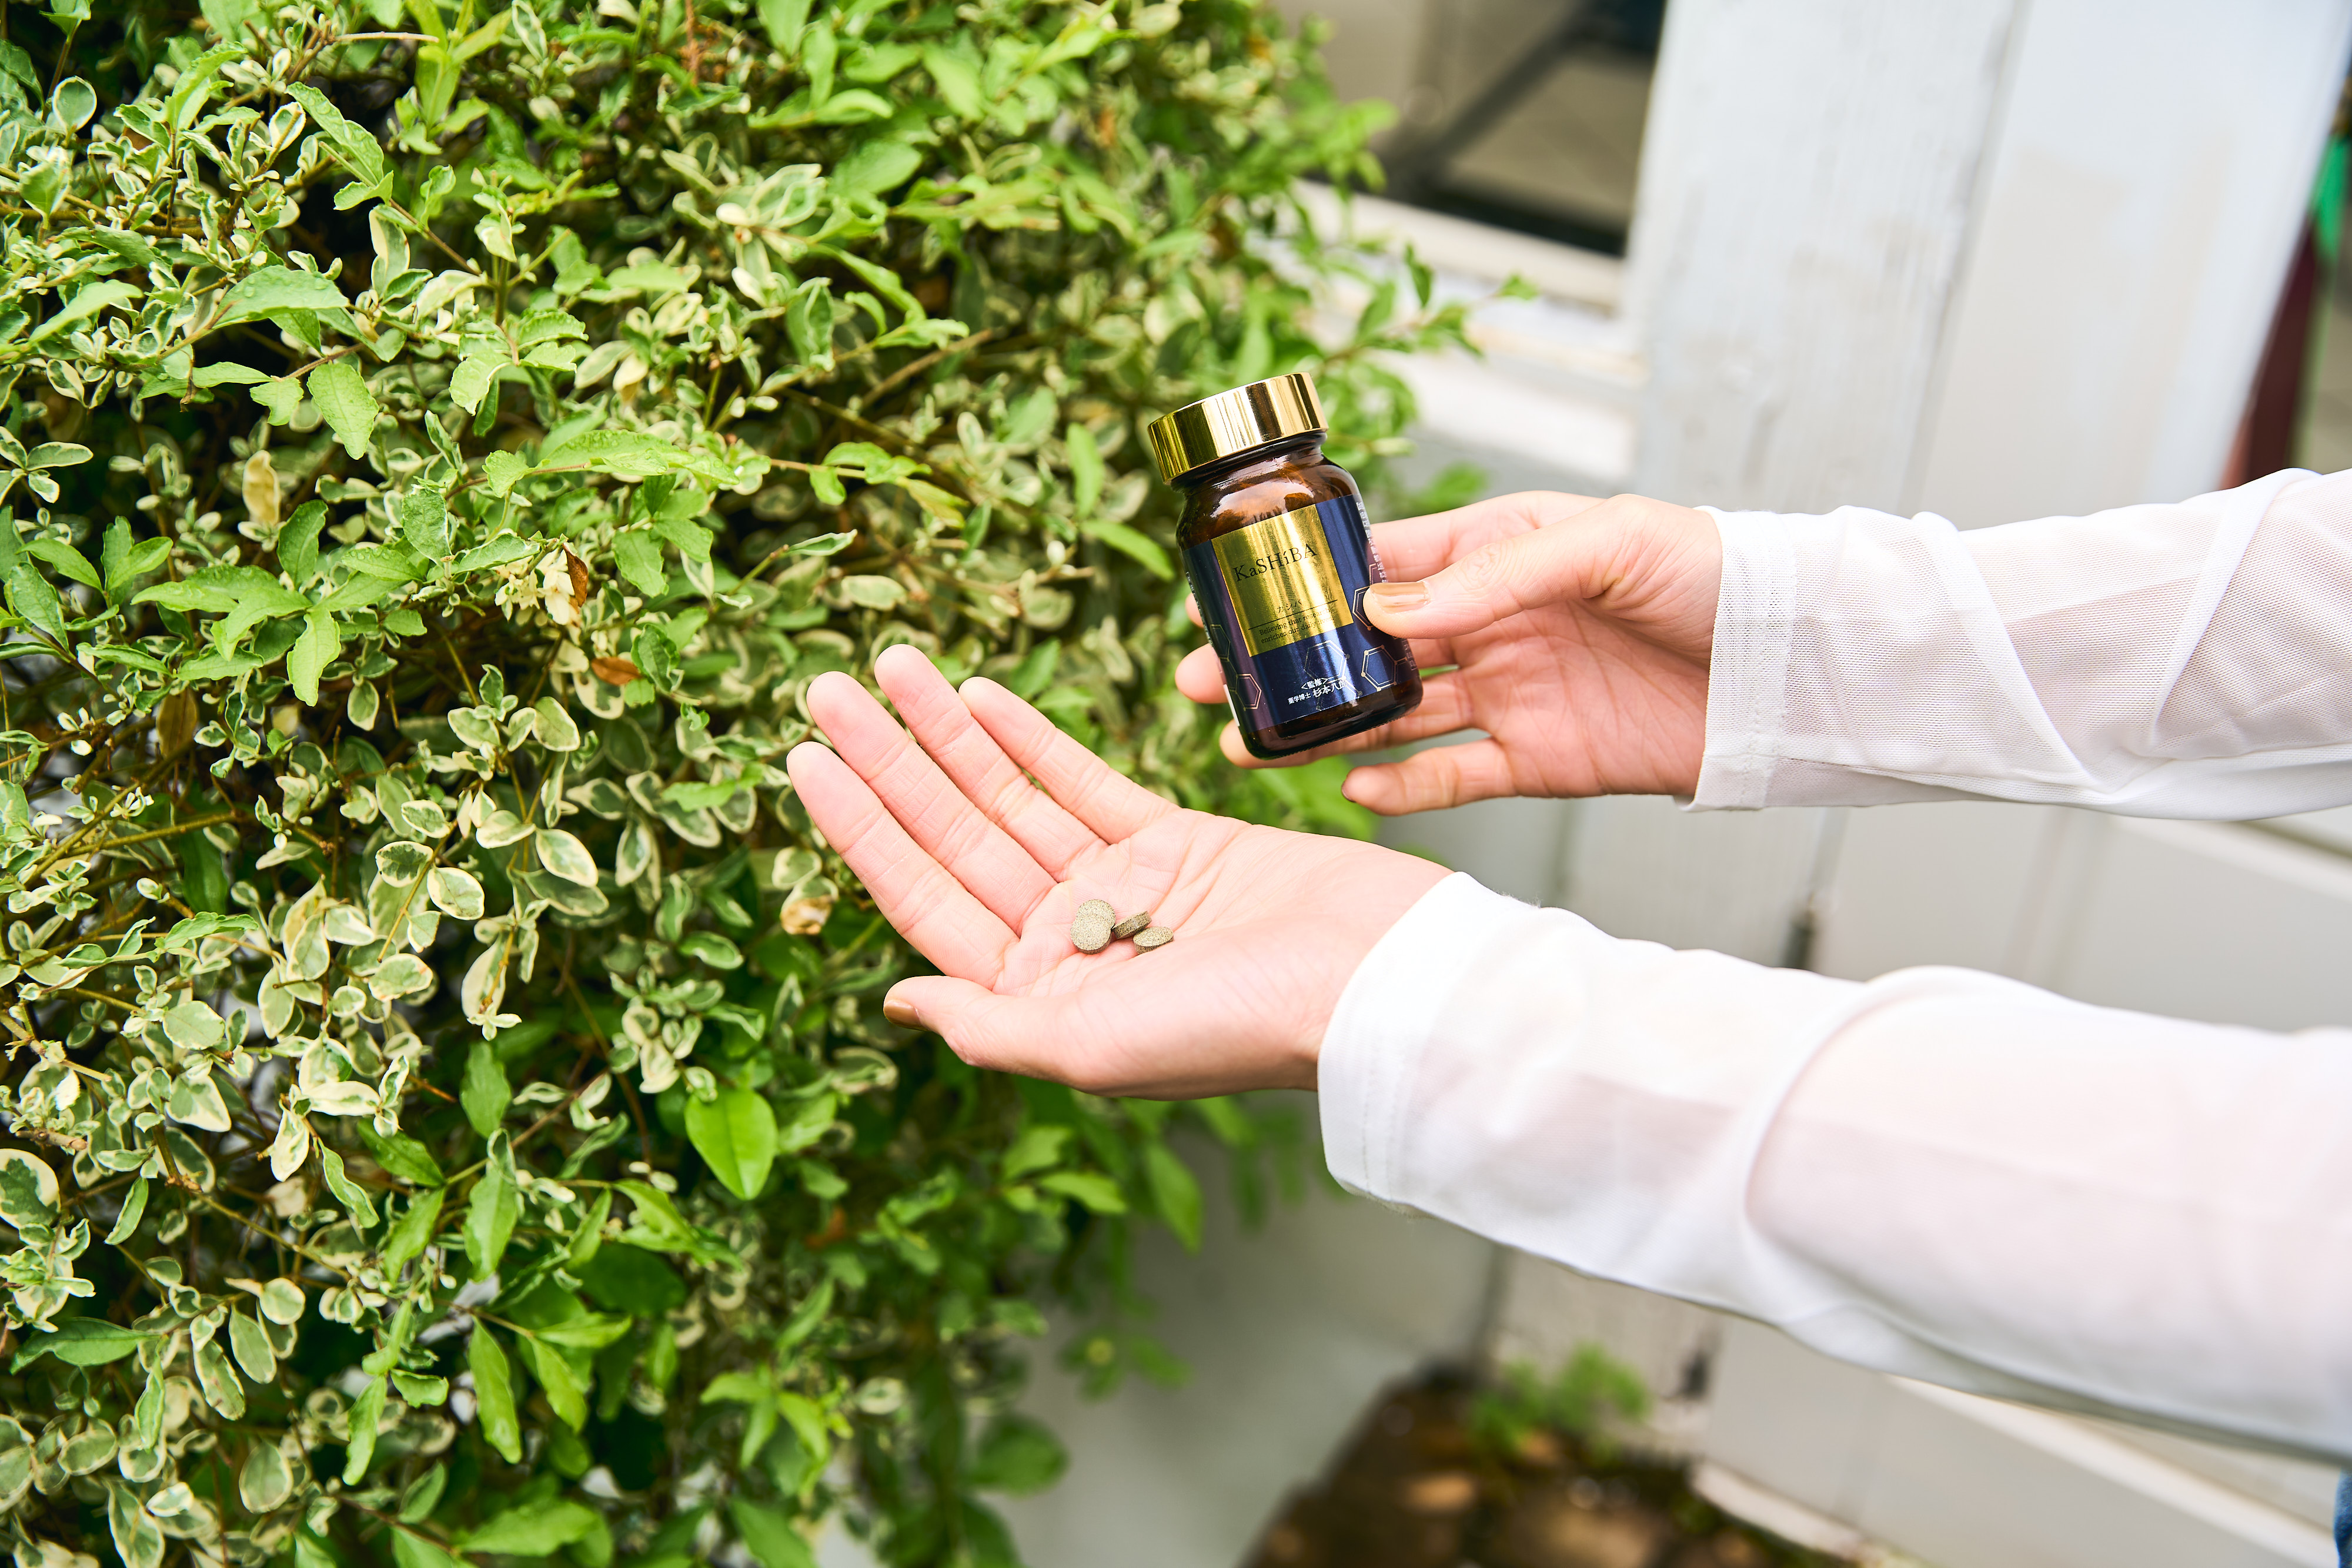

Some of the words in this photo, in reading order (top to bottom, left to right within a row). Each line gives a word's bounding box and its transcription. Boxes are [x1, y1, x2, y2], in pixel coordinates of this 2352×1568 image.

[1277, 599, 1302, 613] カシバ
[1259, 622, 1288, 636] Believing
[1288, 617, 1302, 626] that
[1261, 631, 1287, 643] enriches
[1300, 621, 1317, 630] daily
